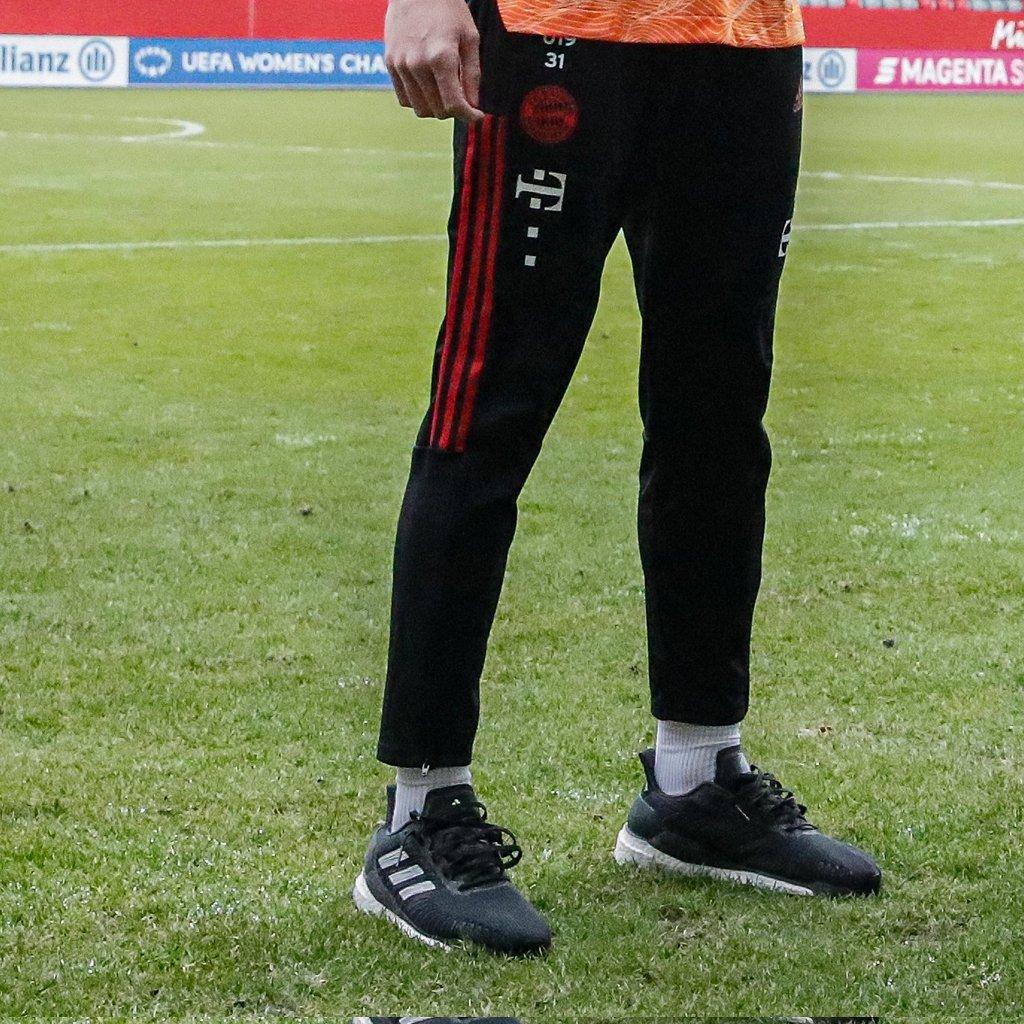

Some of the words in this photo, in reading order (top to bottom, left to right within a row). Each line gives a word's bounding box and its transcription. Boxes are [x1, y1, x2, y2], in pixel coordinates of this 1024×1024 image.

[181, 51, 235, 73] UEFA
[339, 53, 388, 74] CHA
[544, 51, 565, 69] 31
[901, 57, 1009, 85] MAGENTA
